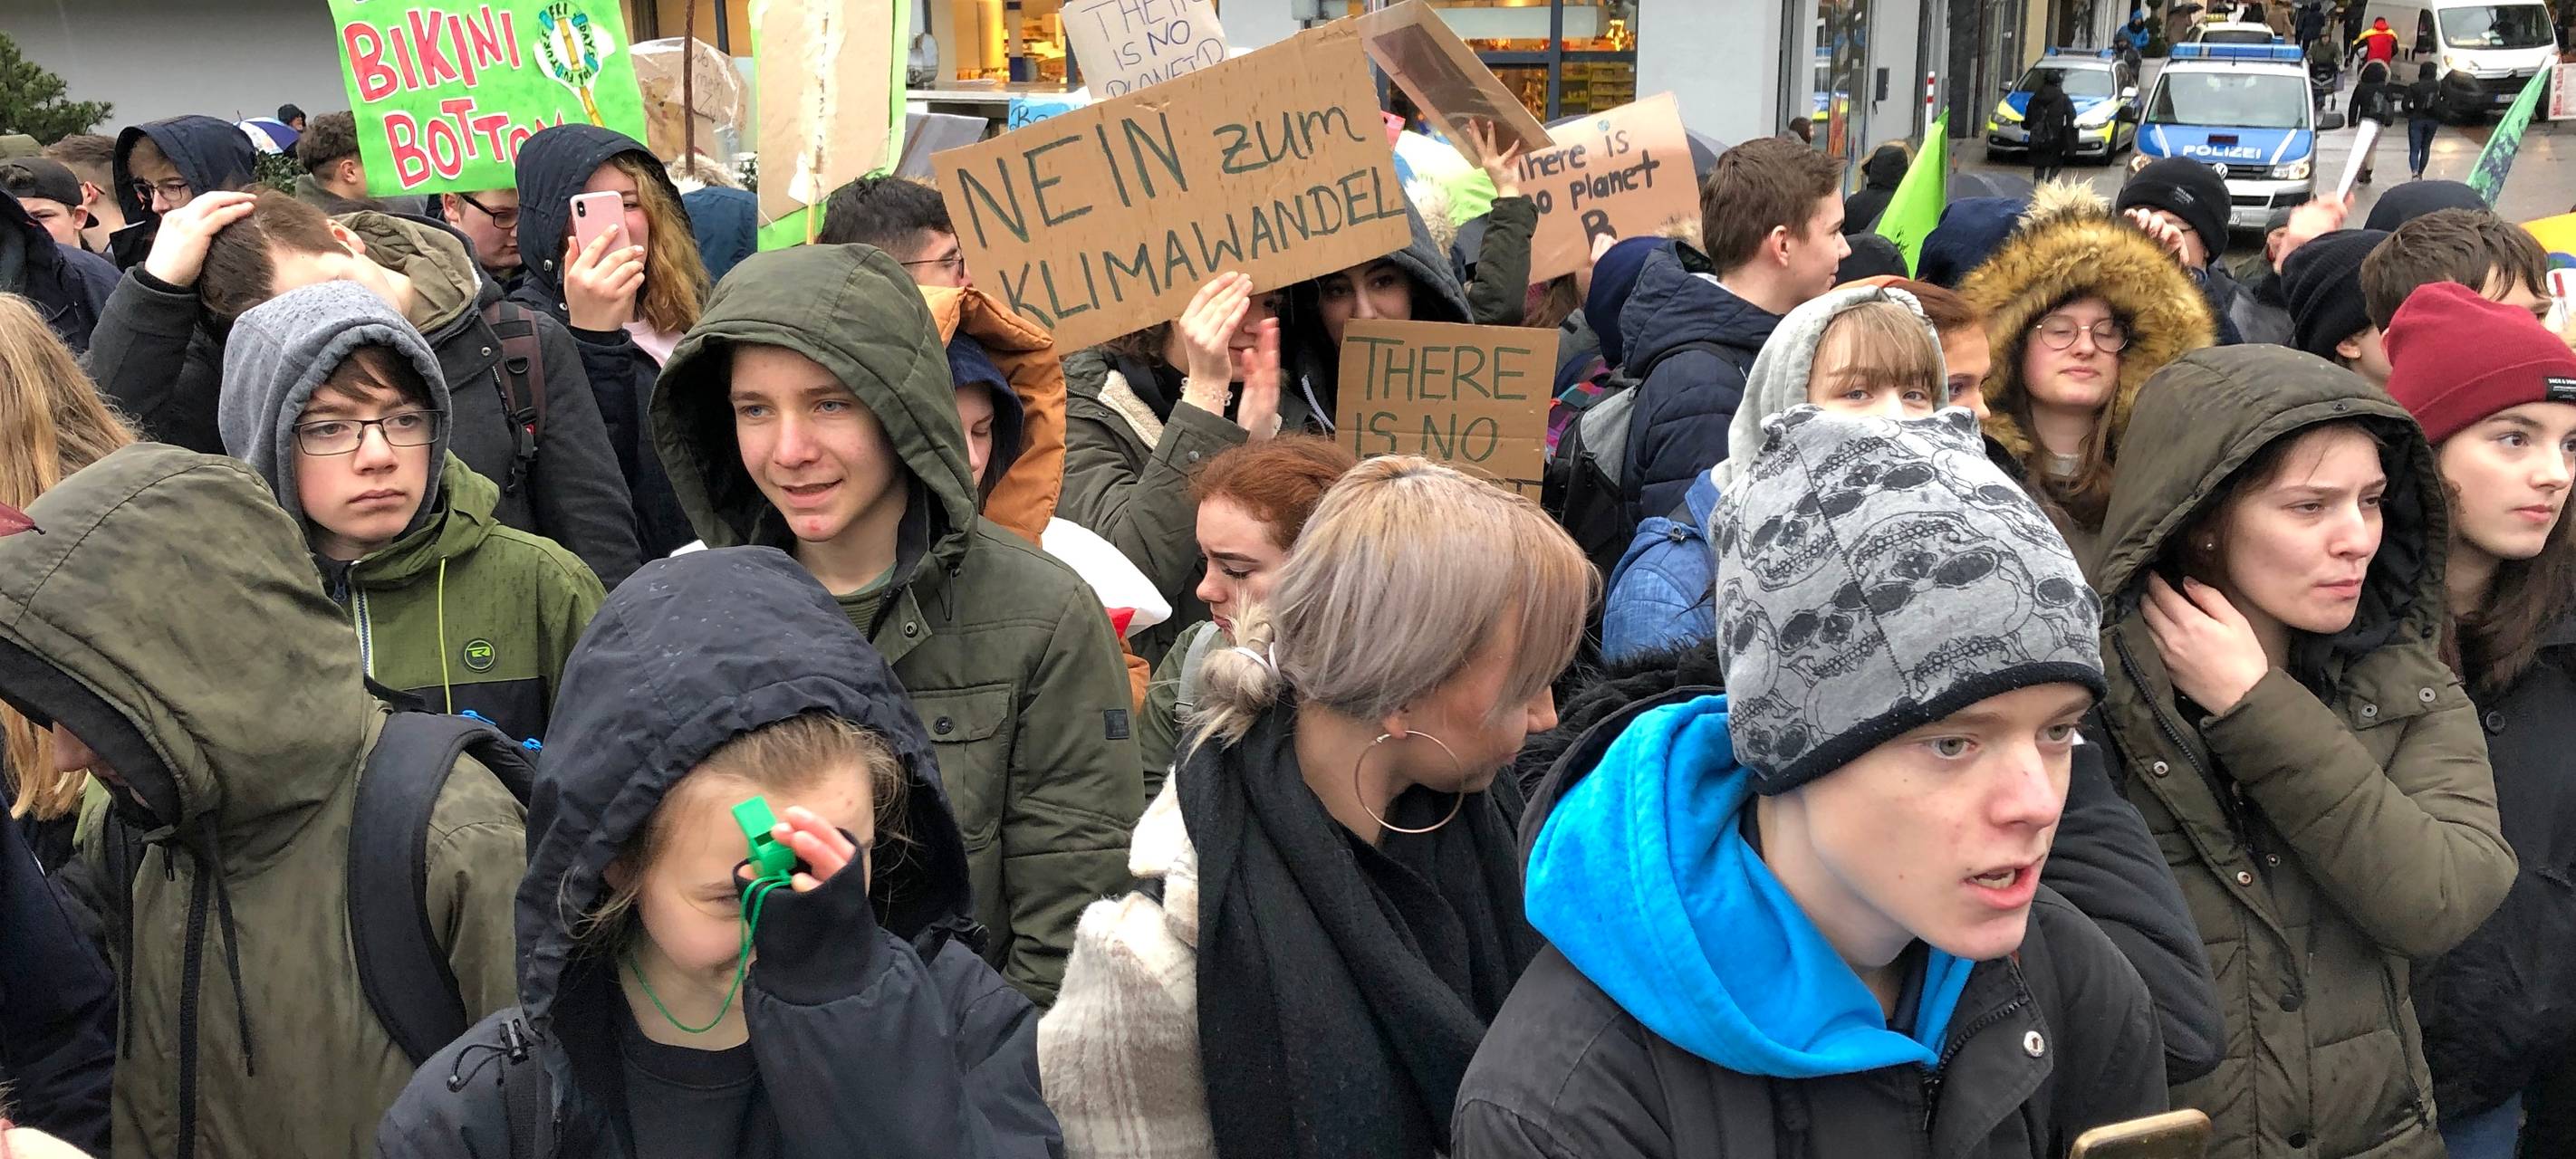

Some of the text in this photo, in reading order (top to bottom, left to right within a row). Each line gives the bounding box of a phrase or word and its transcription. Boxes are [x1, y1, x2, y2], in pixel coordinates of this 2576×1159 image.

[1081, 0, 1205, 42] THE
[1113, 20, 1190, 72] IS NO
[343, 5, 521, 102] BIKINI
[383, 98, 563, 188] BOTTO
[2183, 145, 2262, 159] POLIZEI
[956, 105, 1366, 249] NEIN zum
[1570, 148, 1660, 211] planet
[999, 166, 1406, 330] KLIMAWANDEL
[1347, 336, 1532, 401] THERE
[1355, 411, 1498, 463] IS NO
